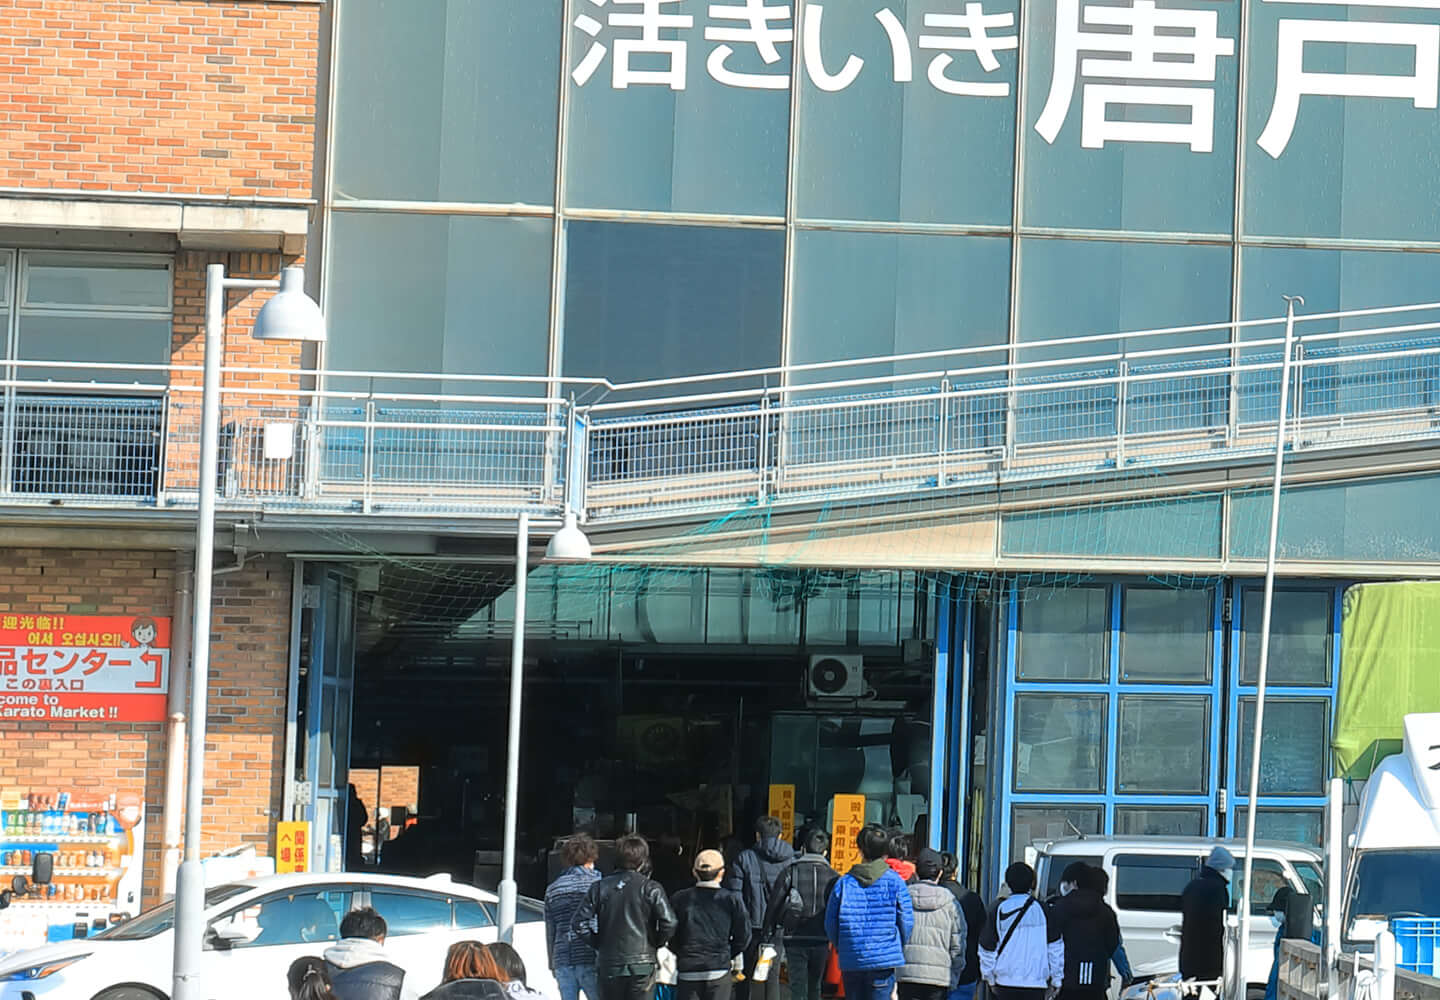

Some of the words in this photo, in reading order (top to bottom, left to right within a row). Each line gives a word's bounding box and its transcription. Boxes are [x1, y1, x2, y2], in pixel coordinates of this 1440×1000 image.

[28, 632, 54, 645] 어서
[43, 694, 58, 705] to
[50, 706, 105, 718] Market
